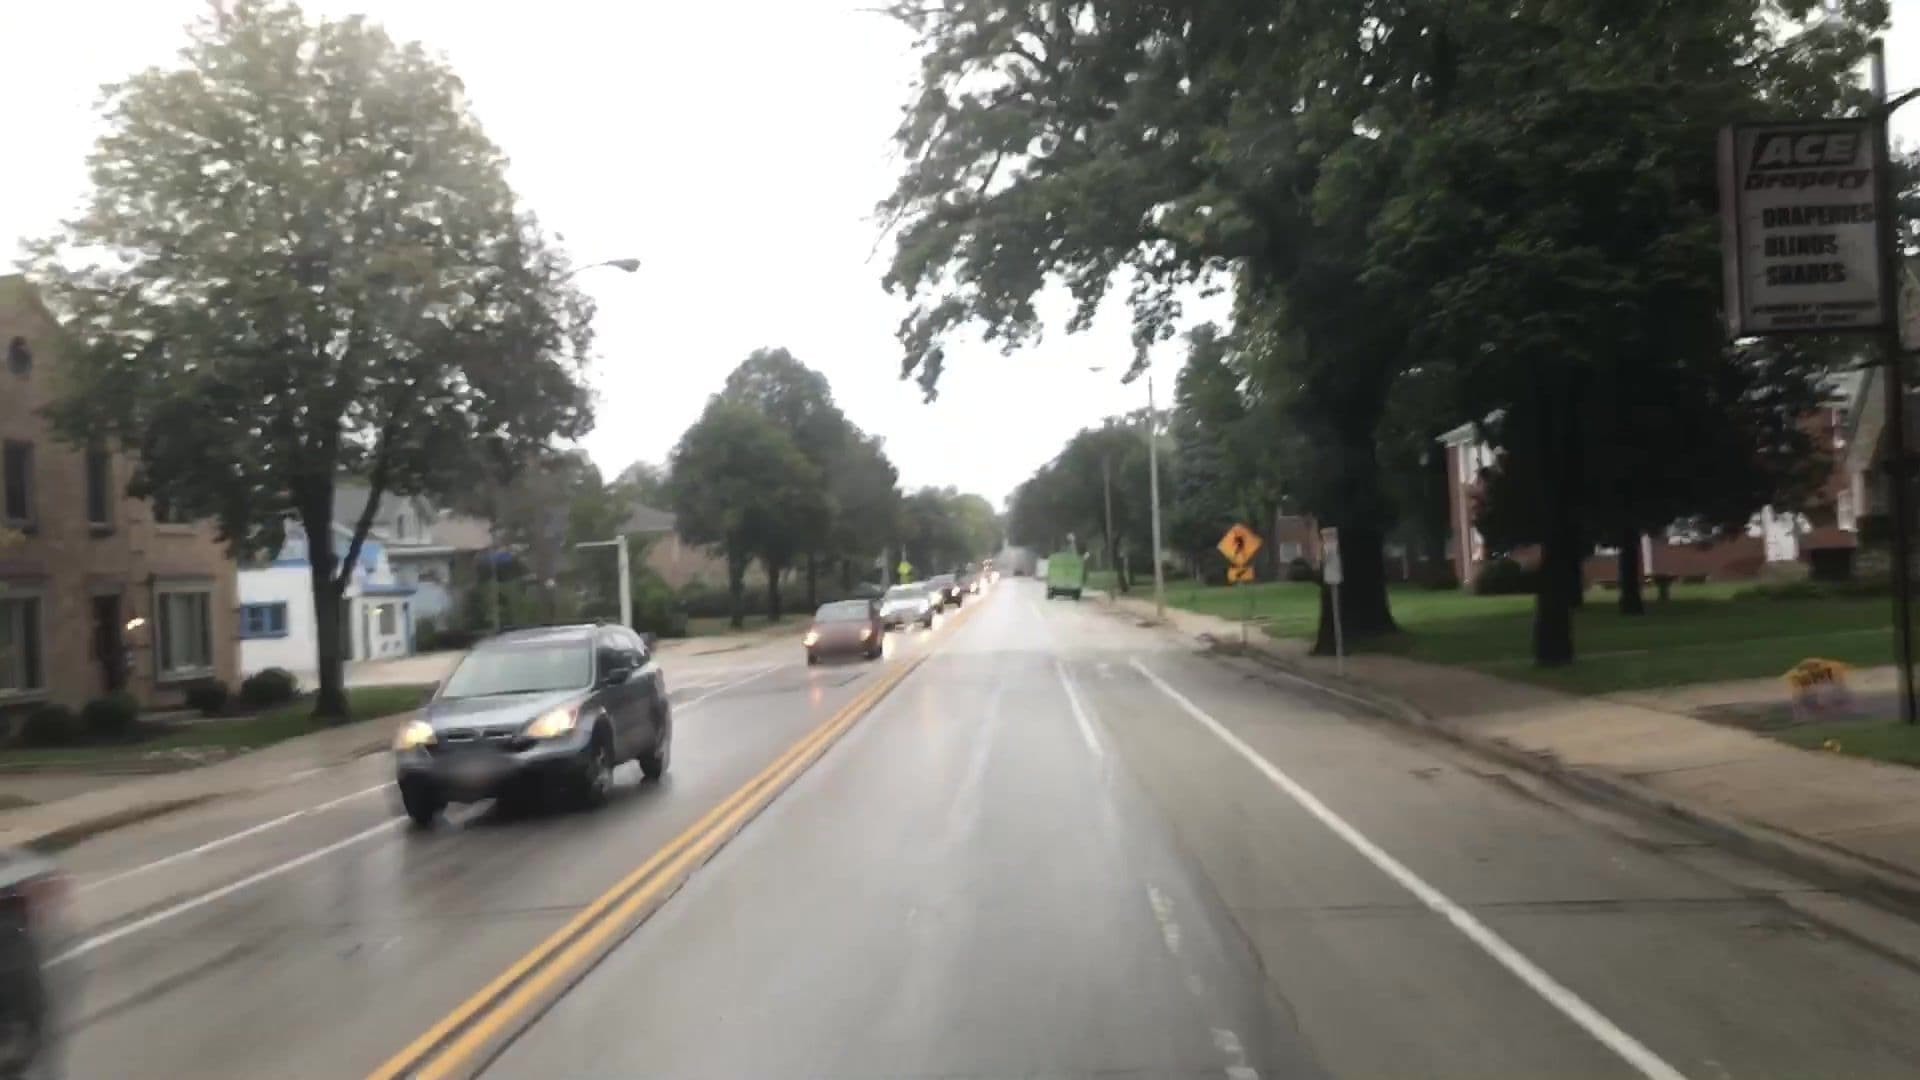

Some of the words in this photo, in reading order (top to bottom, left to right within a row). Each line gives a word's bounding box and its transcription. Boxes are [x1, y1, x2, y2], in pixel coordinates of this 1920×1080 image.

[1755, 133, 1857, 166] ACE
[1763, 203, 1875, 228] DRAPERIES
[1764, 234, 1839, 257] BLINDS
[1766, 262, 1846, 286] SHADES
